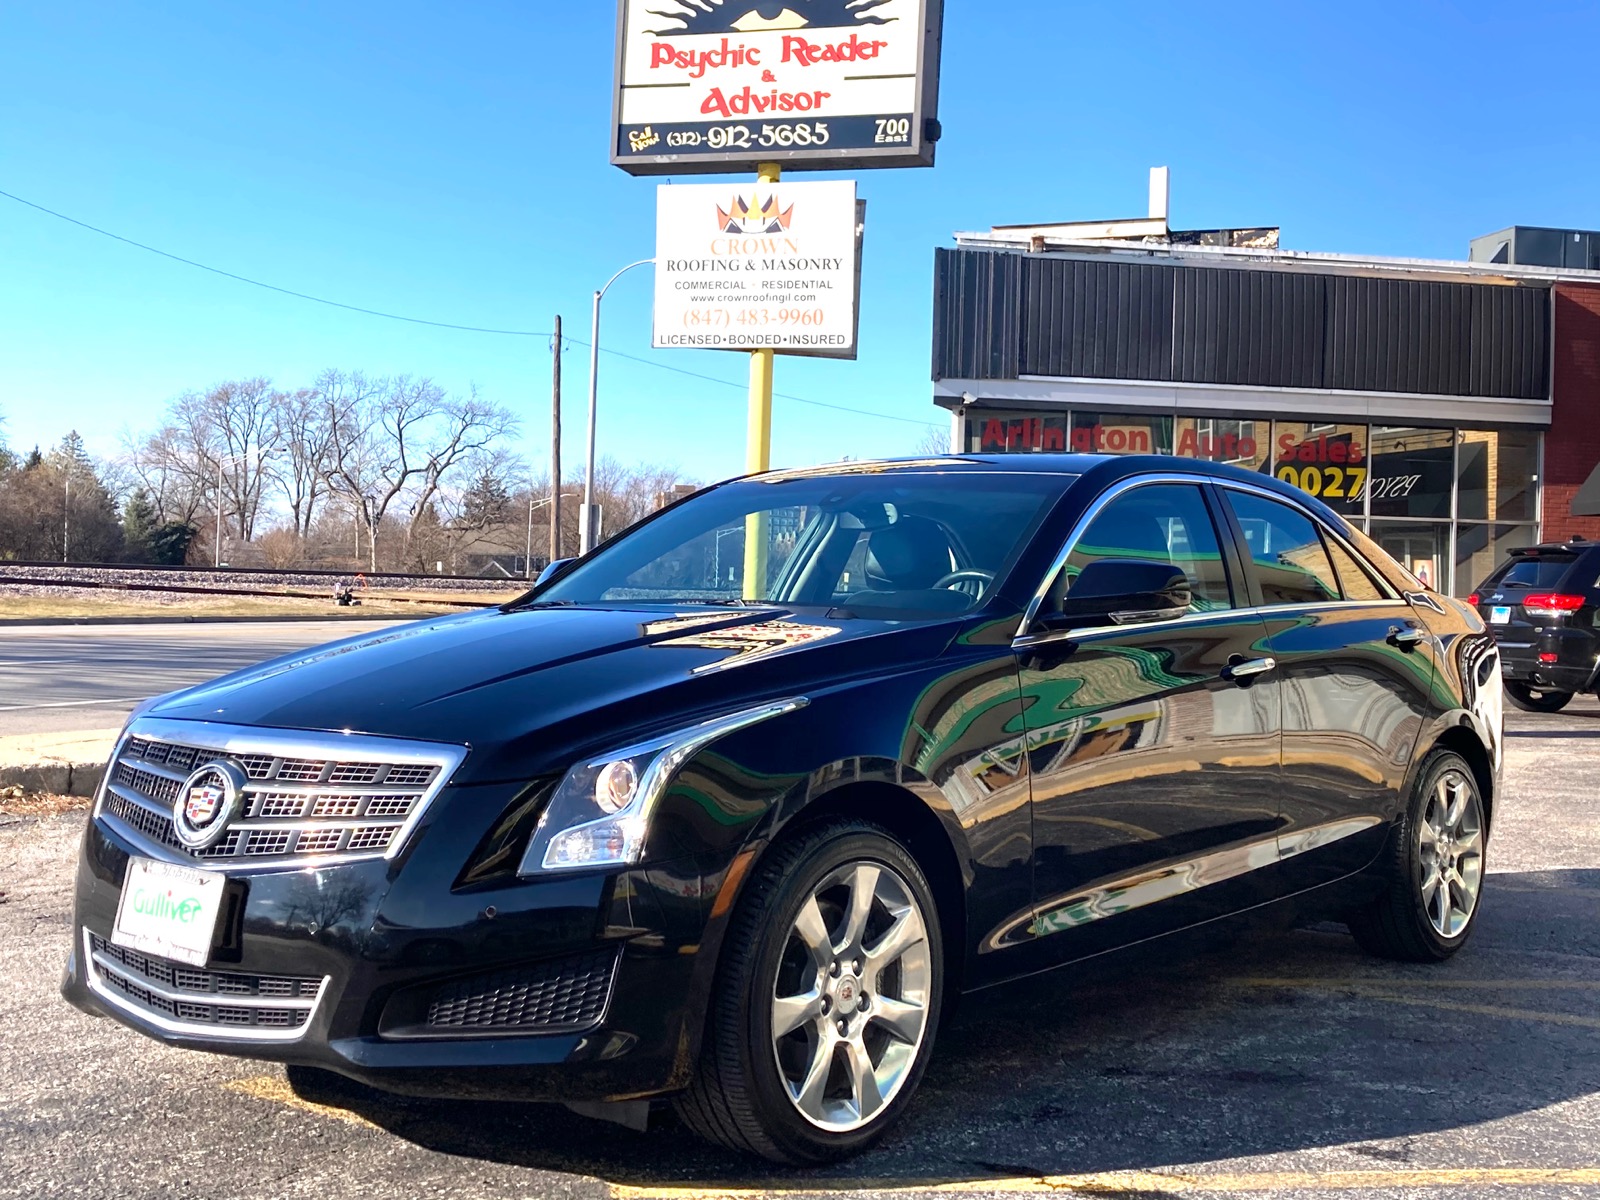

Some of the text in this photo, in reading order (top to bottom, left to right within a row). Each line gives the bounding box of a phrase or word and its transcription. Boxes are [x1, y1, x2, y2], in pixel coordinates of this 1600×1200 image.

[650, 34, 888, 78] Psychic Reader
[761, 69, 777, 82] &
[700, 86, 831, 117] Advisor
[628, 126, 652, 141] Call
[875, 118, 909, 135] 700
[666, 123, 829, 148] (312)-912-5685
[874, 134, 908, 143] East
[711, 238, 798, 255] CROWN
[667, 258, 843, 271] ROOFING & MASONRY
[675, 280, 833, 290] COMMERCIAL RESIDENTIAL
[683, 308, 823, 328] (847) 483-9960
[981, 418, 1362, 463] Arlington Auto Sales
[133, 888, 202, 923] Gulliver
